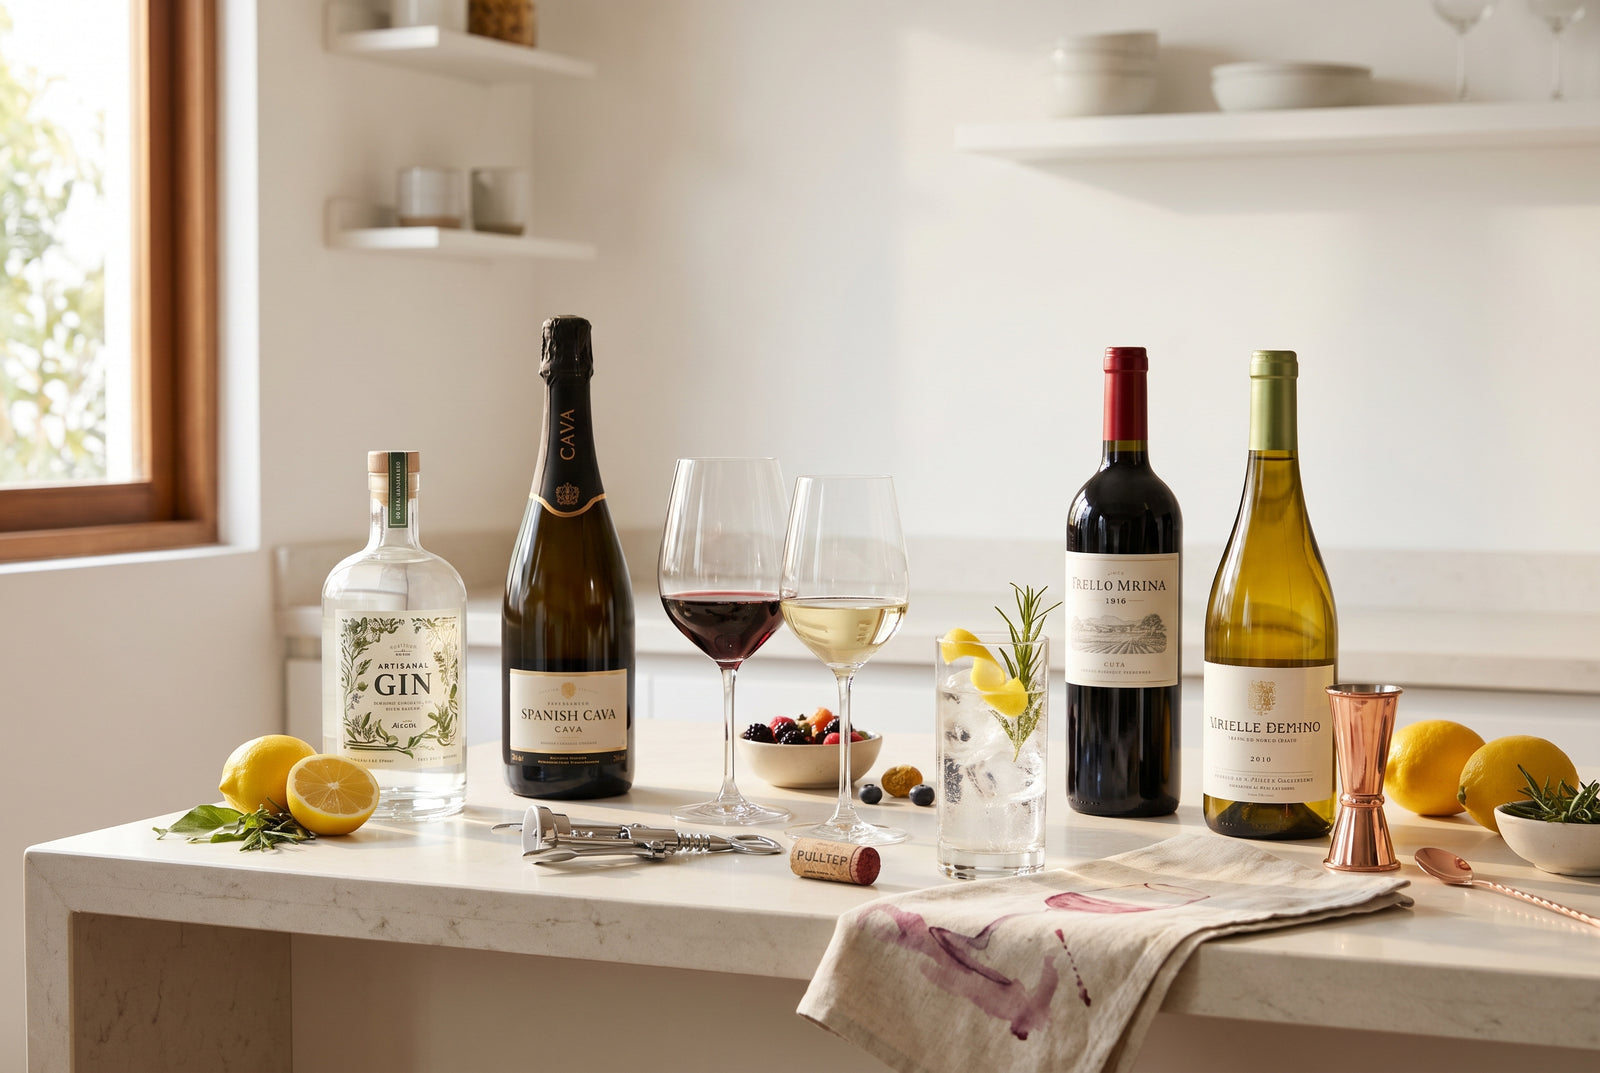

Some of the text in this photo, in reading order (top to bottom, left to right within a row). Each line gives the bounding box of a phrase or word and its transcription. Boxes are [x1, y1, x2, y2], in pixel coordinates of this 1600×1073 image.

[560, 408, 575, 461] CAVA
[1117, 579, 1167, 592] MRINA
[1105, 597, 1127, 605] 1916
[378, 662, 429, 670] ARTISANAL
[374, 672, 432, 696] GIN
[521, 708, 616, 722] SPANISH CAVA
